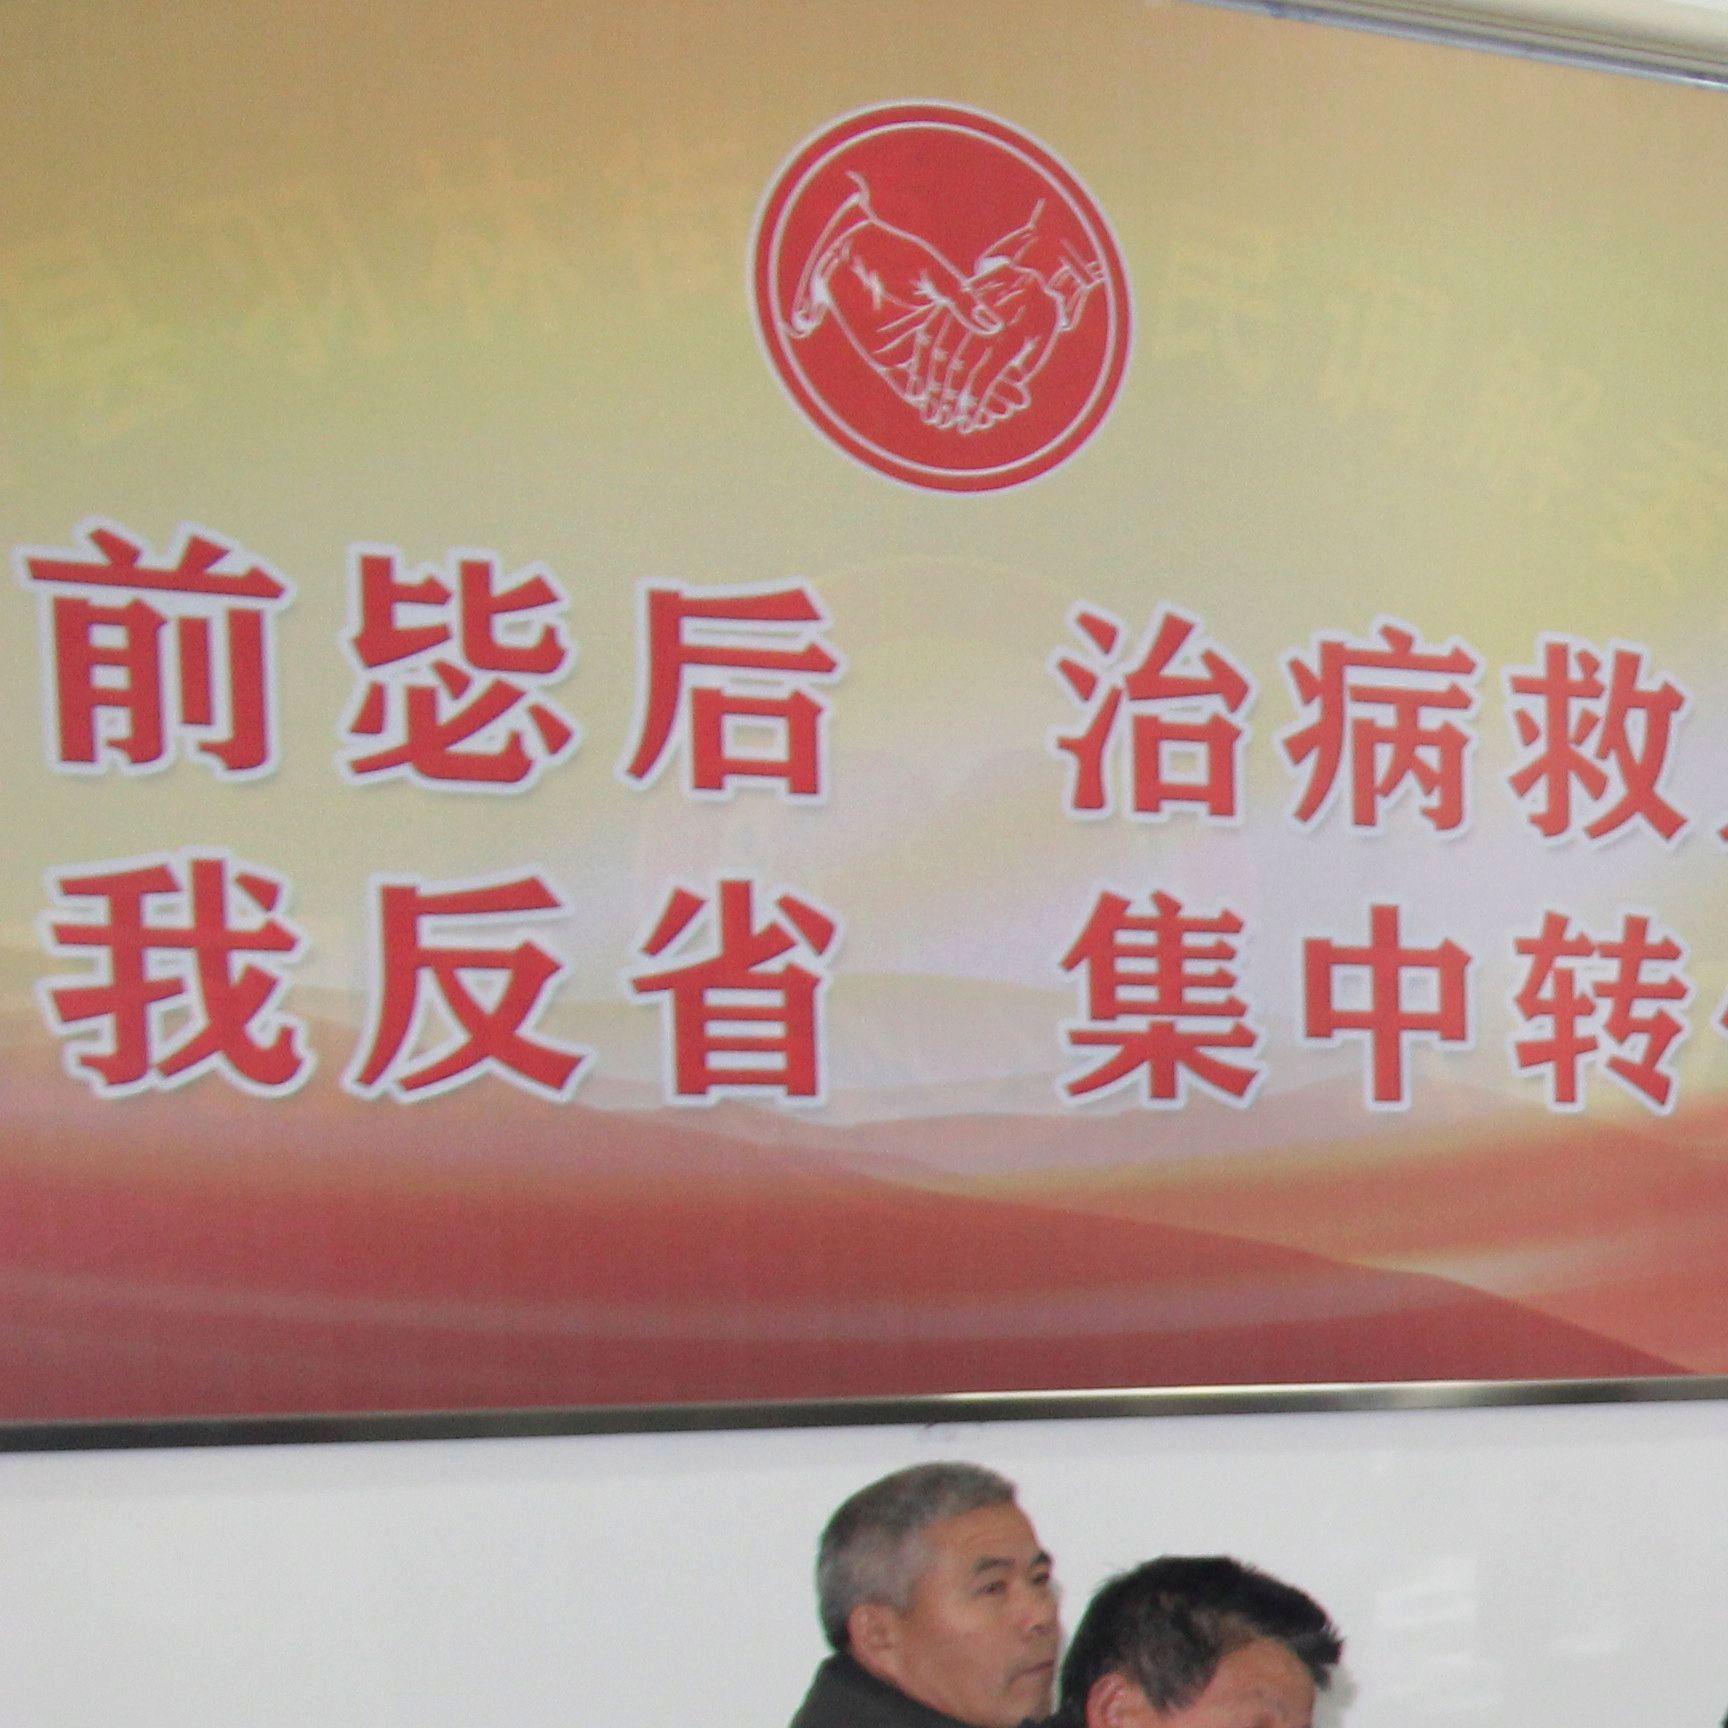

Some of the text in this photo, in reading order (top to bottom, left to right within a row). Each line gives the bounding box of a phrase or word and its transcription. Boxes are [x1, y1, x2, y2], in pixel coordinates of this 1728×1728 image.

[30, 530, 835, 794] 前毖后
[54, 859, 834, 1096] 我反省
